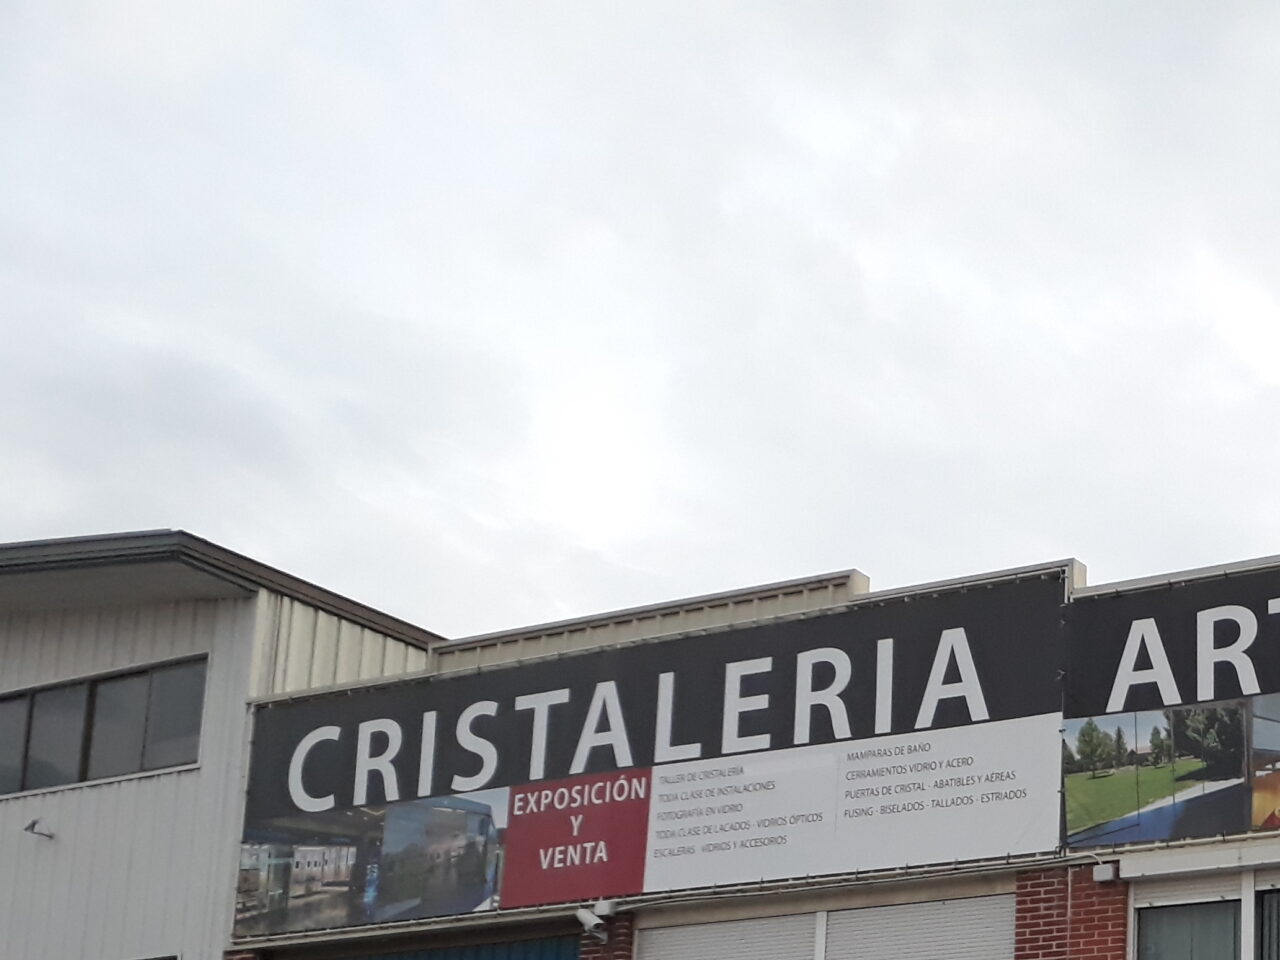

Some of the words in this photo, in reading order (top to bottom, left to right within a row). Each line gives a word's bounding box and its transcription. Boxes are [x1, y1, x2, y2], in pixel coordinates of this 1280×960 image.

[287, 627, 990, 813] CRISTALERIA
[846, 747, 893, 761] MAMPARAS
[894, 745, 906, 756] DE
[907, 742, 931, 755] BAÑO
[659, 773, 685, 785] TALLER
[687, 772, 697, 782] DE
[845, 763, 907, 781] CERRAMIENTOS
[908, 761, 938, 774] VIDRIO
[938, 760, 944, 769] Y
[945, 756, 974, 769] ACERO
[513, 774, 647, 816] EXPOSICIÓN
[680, 789, 703, 801] CLASE
[705, 787, 715, 798] DE
[717, 780, 776, 796] INSTALACIONES
[845, 787, 880, 800] PUERTAS
[882, 784, 892, 795] DE
[894, 781, 925, 794] CRISTAL
[933, 775, 976, 789] ABATIBLES
[977, 774, 982, 784] Y
[706, 805, 716, 816] EN
[716, 803, 744, 815] VIDRIO
[844, 806, 874, 818] FUSING
[880, 800, 925, 815] BISELADOS
[931, 794, 974, 809] TALLADOS
[980, 788, 1027, 804] ESTRIADOS
[570, 815, 585, 837] Y
[679, 827, 702, 838] CLASE
[703, 824, 713, 835] DE
[714, 819, 750, 834] LACADOS
[756, 816, 787, 828] VIDRIOS
[539, 841, 609, 869] VENTA
[653, 845, 696, 859] ESCALERAS
[702, 841, 731, 853] VIDRIOS
[739, 834, 788, 849] ACCESORIOS
